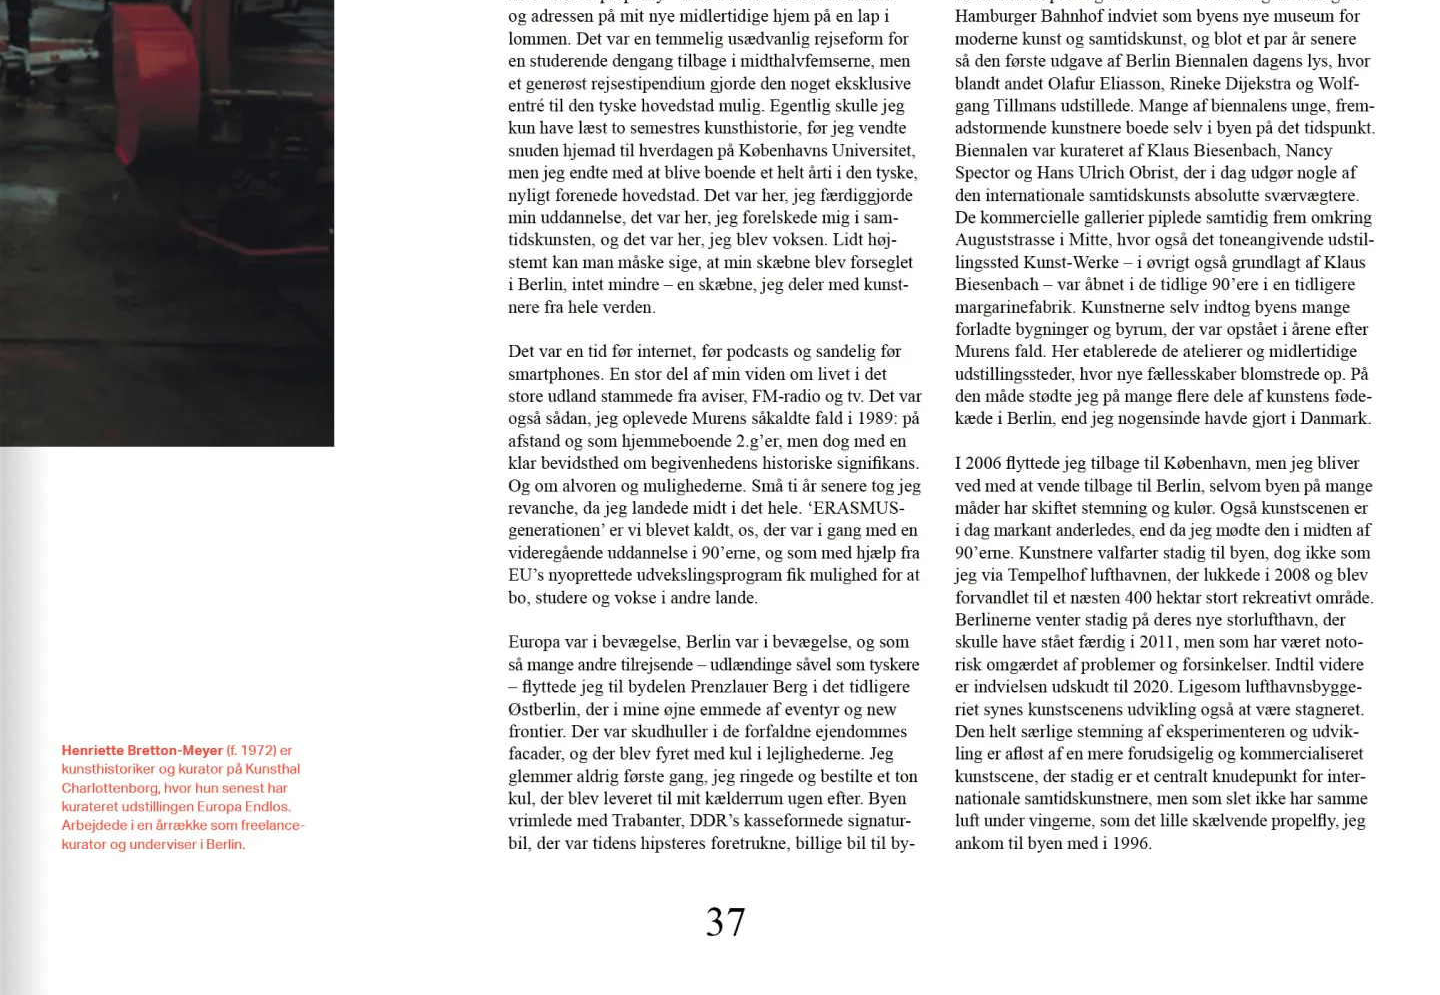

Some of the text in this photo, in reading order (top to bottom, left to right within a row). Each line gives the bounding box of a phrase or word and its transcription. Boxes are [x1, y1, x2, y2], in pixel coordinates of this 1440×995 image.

[61, 744, 293, 759] Henriette Bretton-Meyer (f. 1972) er
[61, 762, 301, 777] kunsthistoriker og kurator på Kunsthal
[61, 782, 288, 797] Charlottenborg, hvor hun senest har
[61, 800, 291, 815] kurateret udstillingen Europa Endlos.
[61, 818, 305, 834] Arbejdede i en årrække som freelance-
[61, 838, 246, 853] kurator og underviser i Berlin.
[955, 835, 1152, 854] ankom til byen med i 1996.
[706, 906, 746, 937] 37
